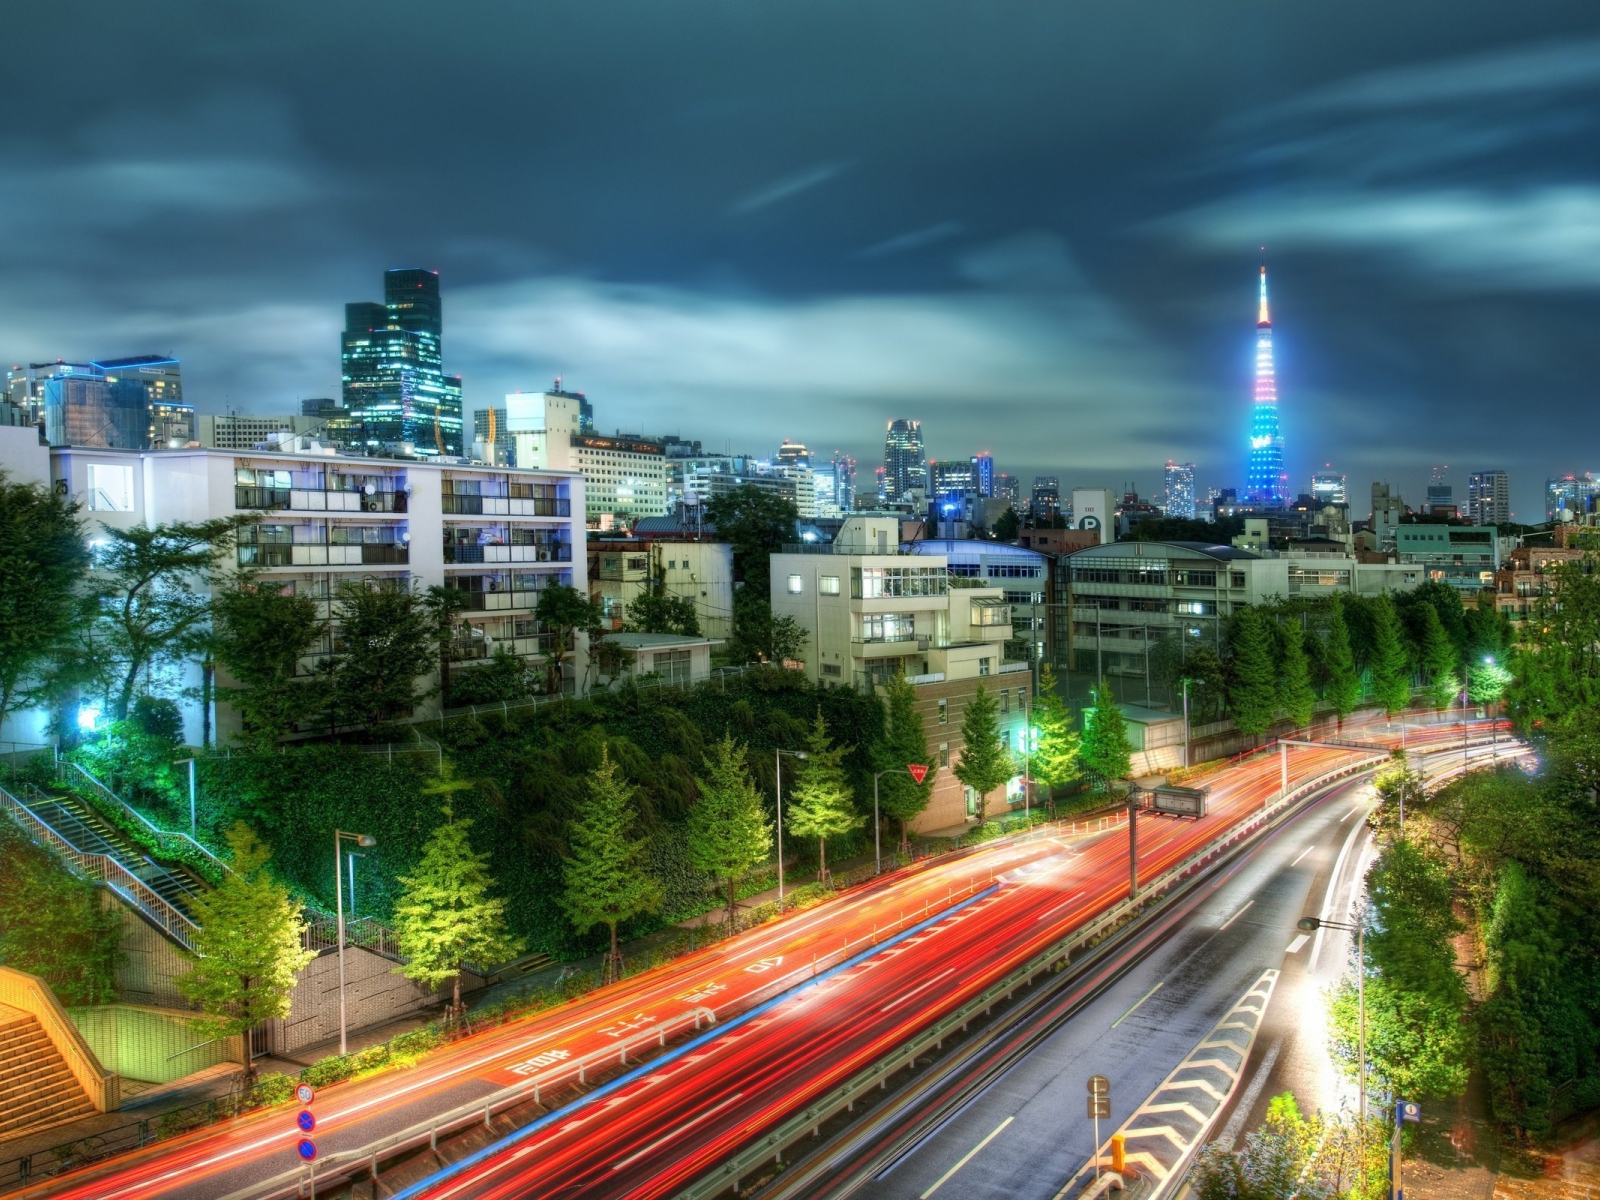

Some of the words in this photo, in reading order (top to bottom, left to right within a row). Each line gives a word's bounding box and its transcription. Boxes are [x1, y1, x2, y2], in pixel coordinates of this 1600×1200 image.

[55, 479, 68, 495] 25
[1084, 518, 1097, 530] P
[299, 1088, 311, 1100] 50
